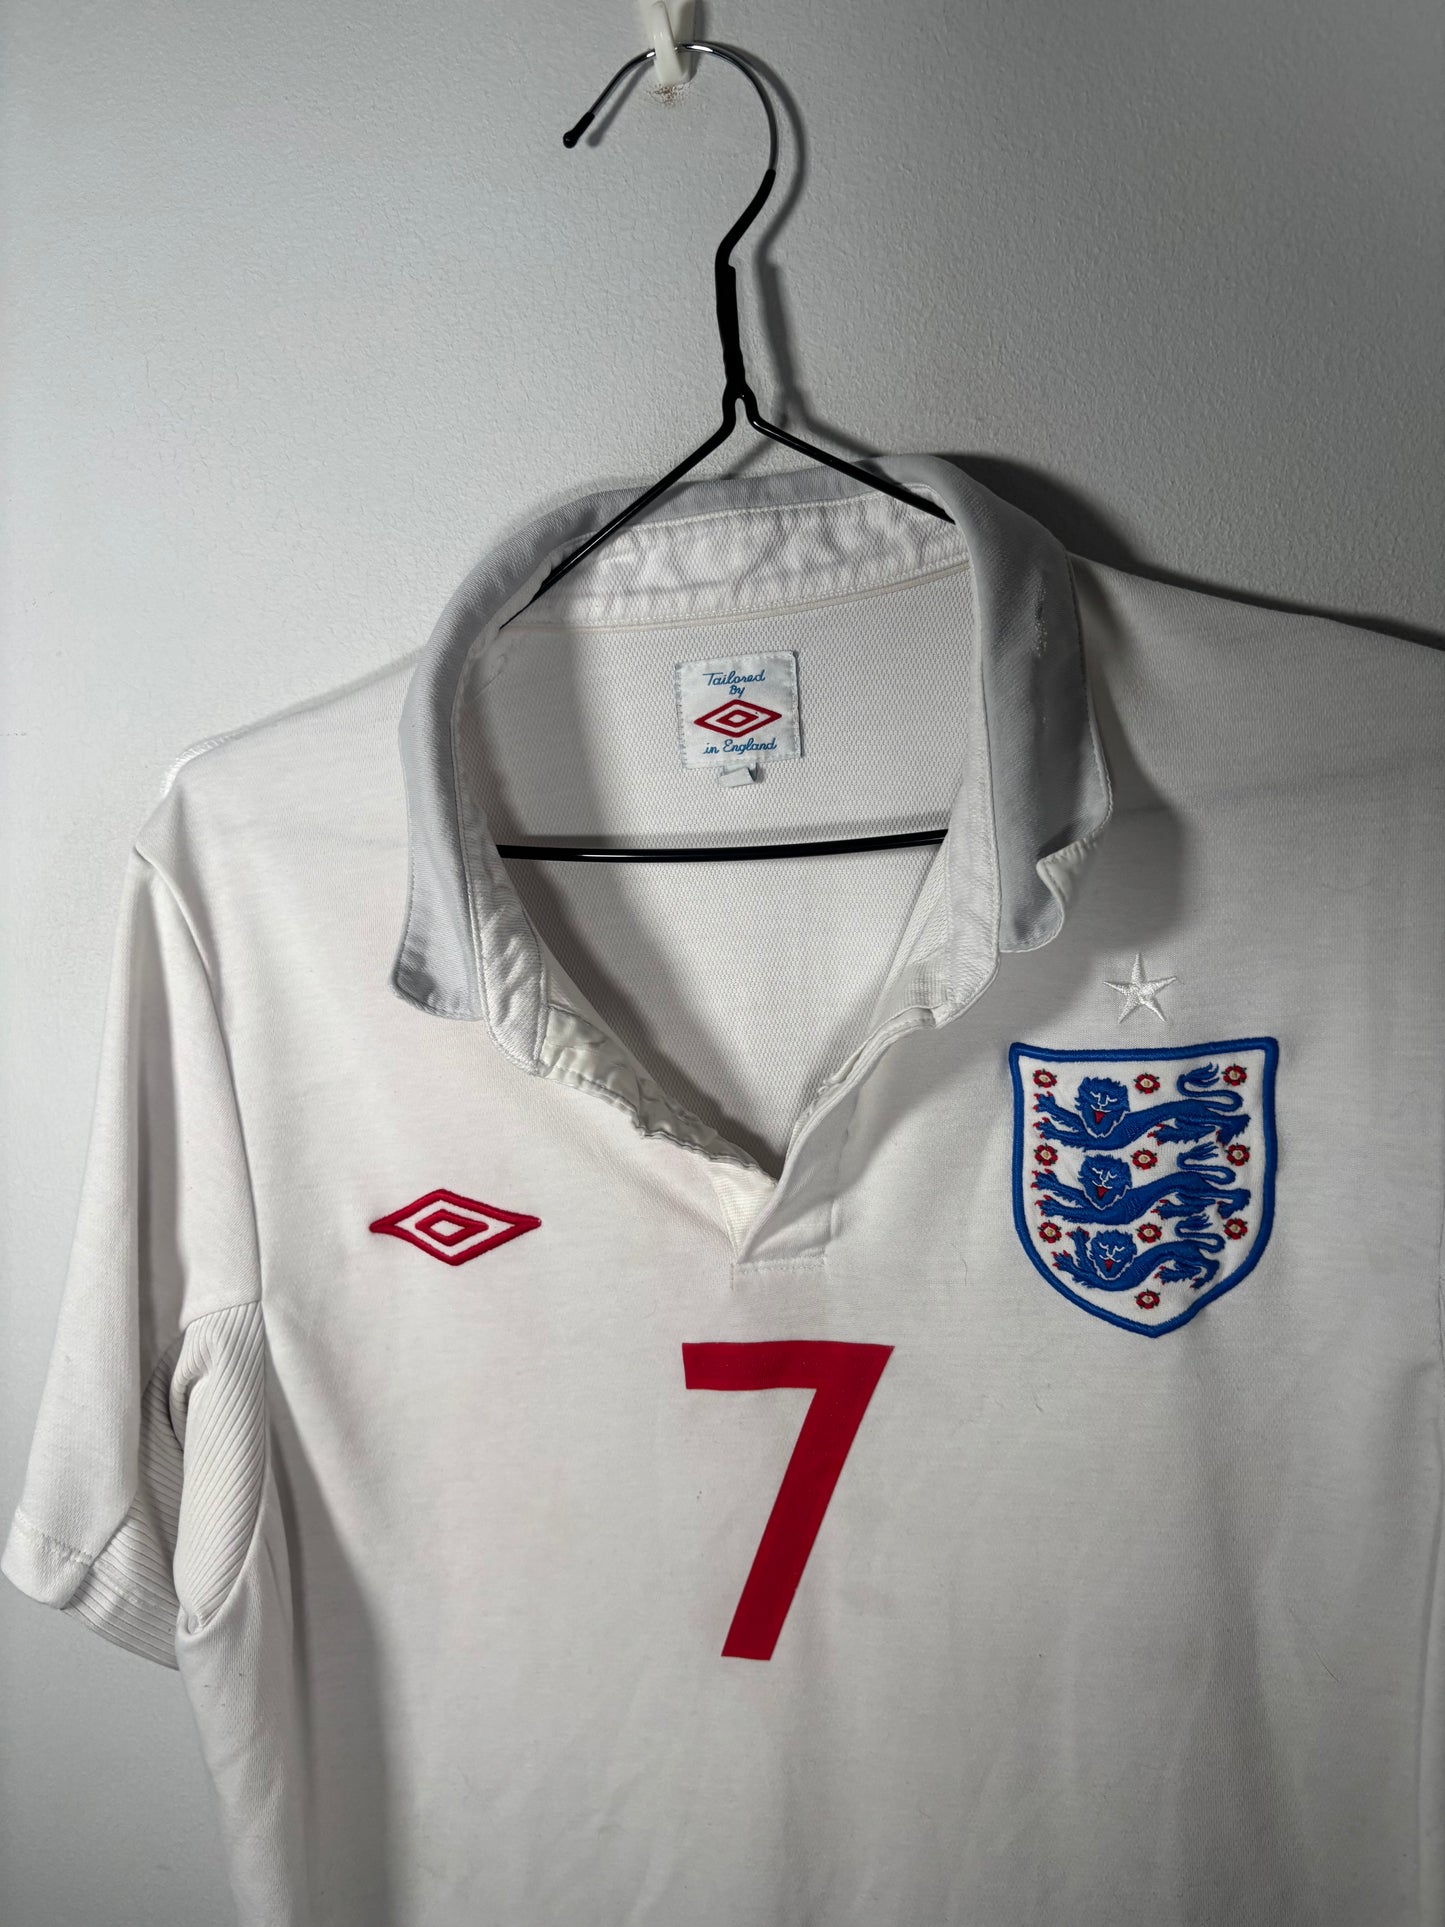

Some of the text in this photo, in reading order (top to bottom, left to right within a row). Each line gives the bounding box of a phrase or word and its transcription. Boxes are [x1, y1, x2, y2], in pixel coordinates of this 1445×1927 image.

[702, 669, 765, 686] Tailored
[703, 737, 777, 755] in England
[682, 1340, 895, 1661] 7
